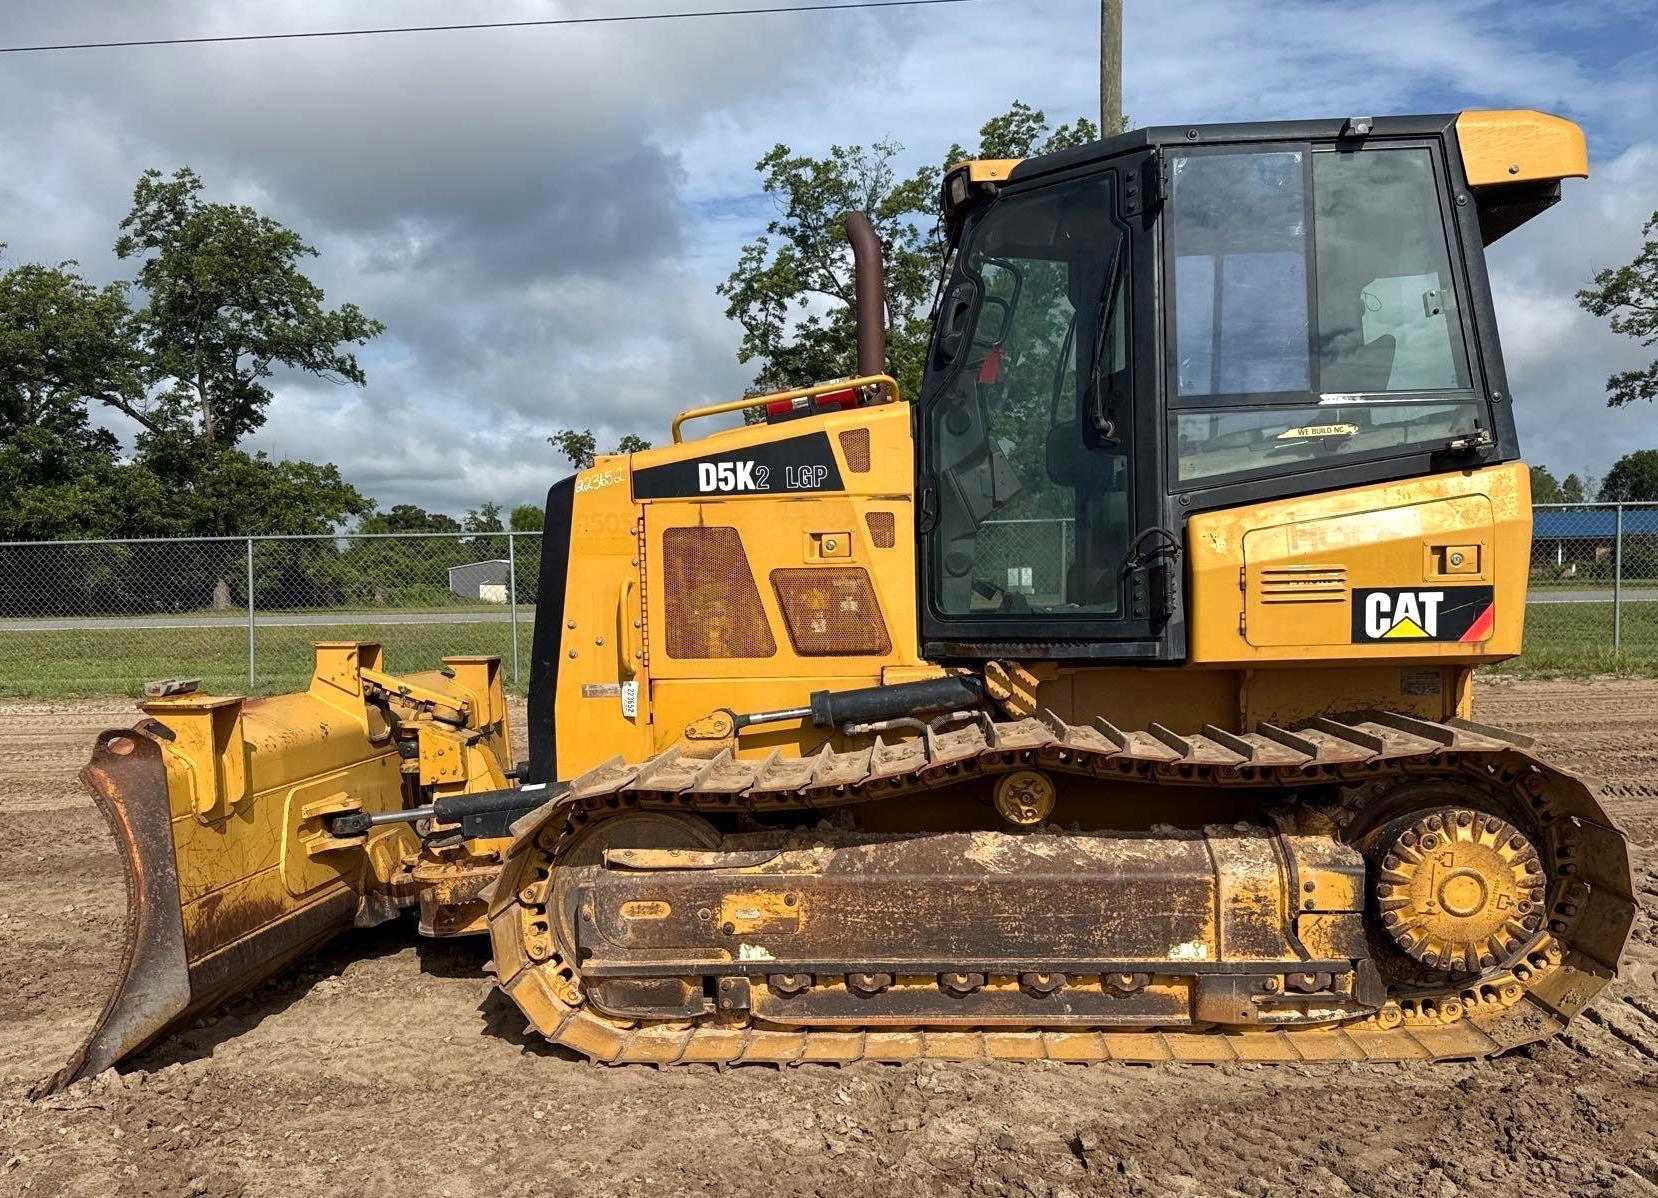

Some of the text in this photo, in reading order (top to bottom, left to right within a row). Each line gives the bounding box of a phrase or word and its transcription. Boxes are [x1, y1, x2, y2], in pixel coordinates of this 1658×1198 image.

[1311, 427, 1332, 435] BUILD
[575, 467, 624, 493] 223652
[785, 465, 828, 489] LGP
[1365, 592, 1444, 638] CAT
[627, 688, 635, 713] 223652
